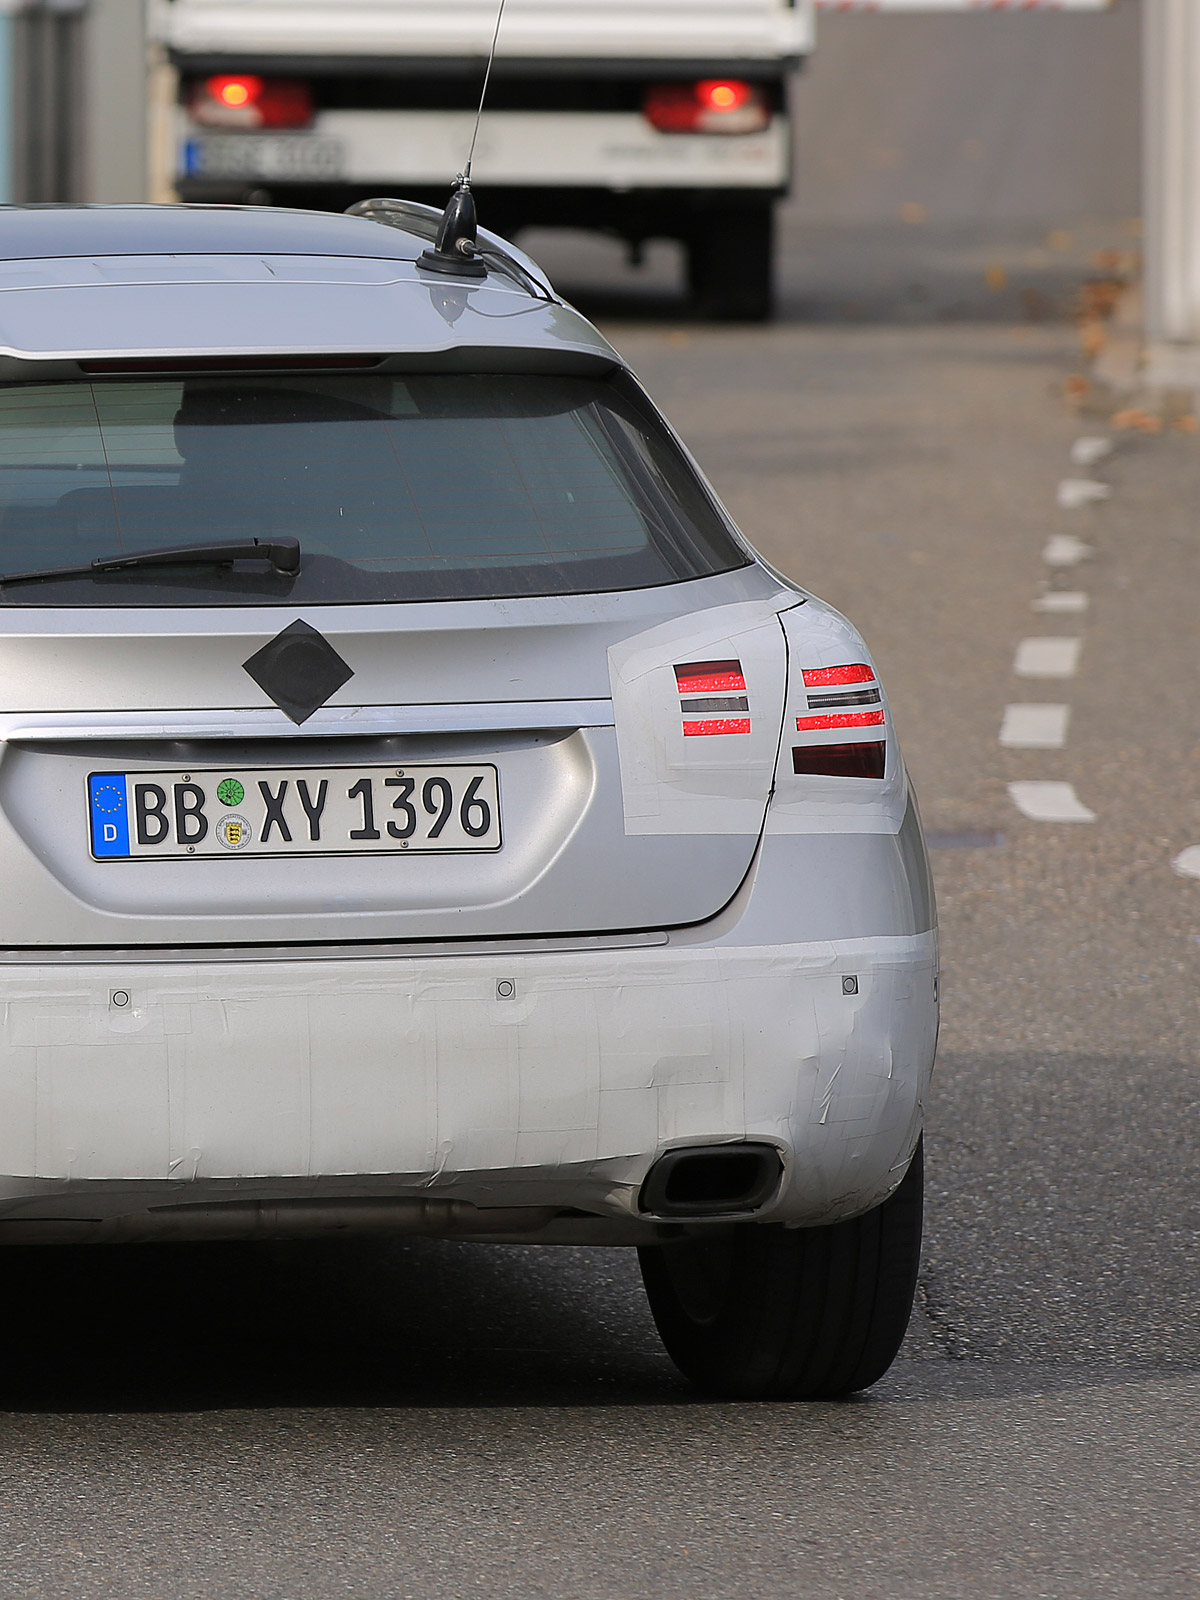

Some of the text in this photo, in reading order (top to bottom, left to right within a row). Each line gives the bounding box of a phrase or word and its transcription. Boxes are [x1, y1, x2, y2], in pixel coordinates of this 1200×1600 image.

[103, 823, 118, 842] D
[134, 783, 208, 845] BB
[258, 780, 328, 842] XY
[347, 776, 491, 840] 1396
